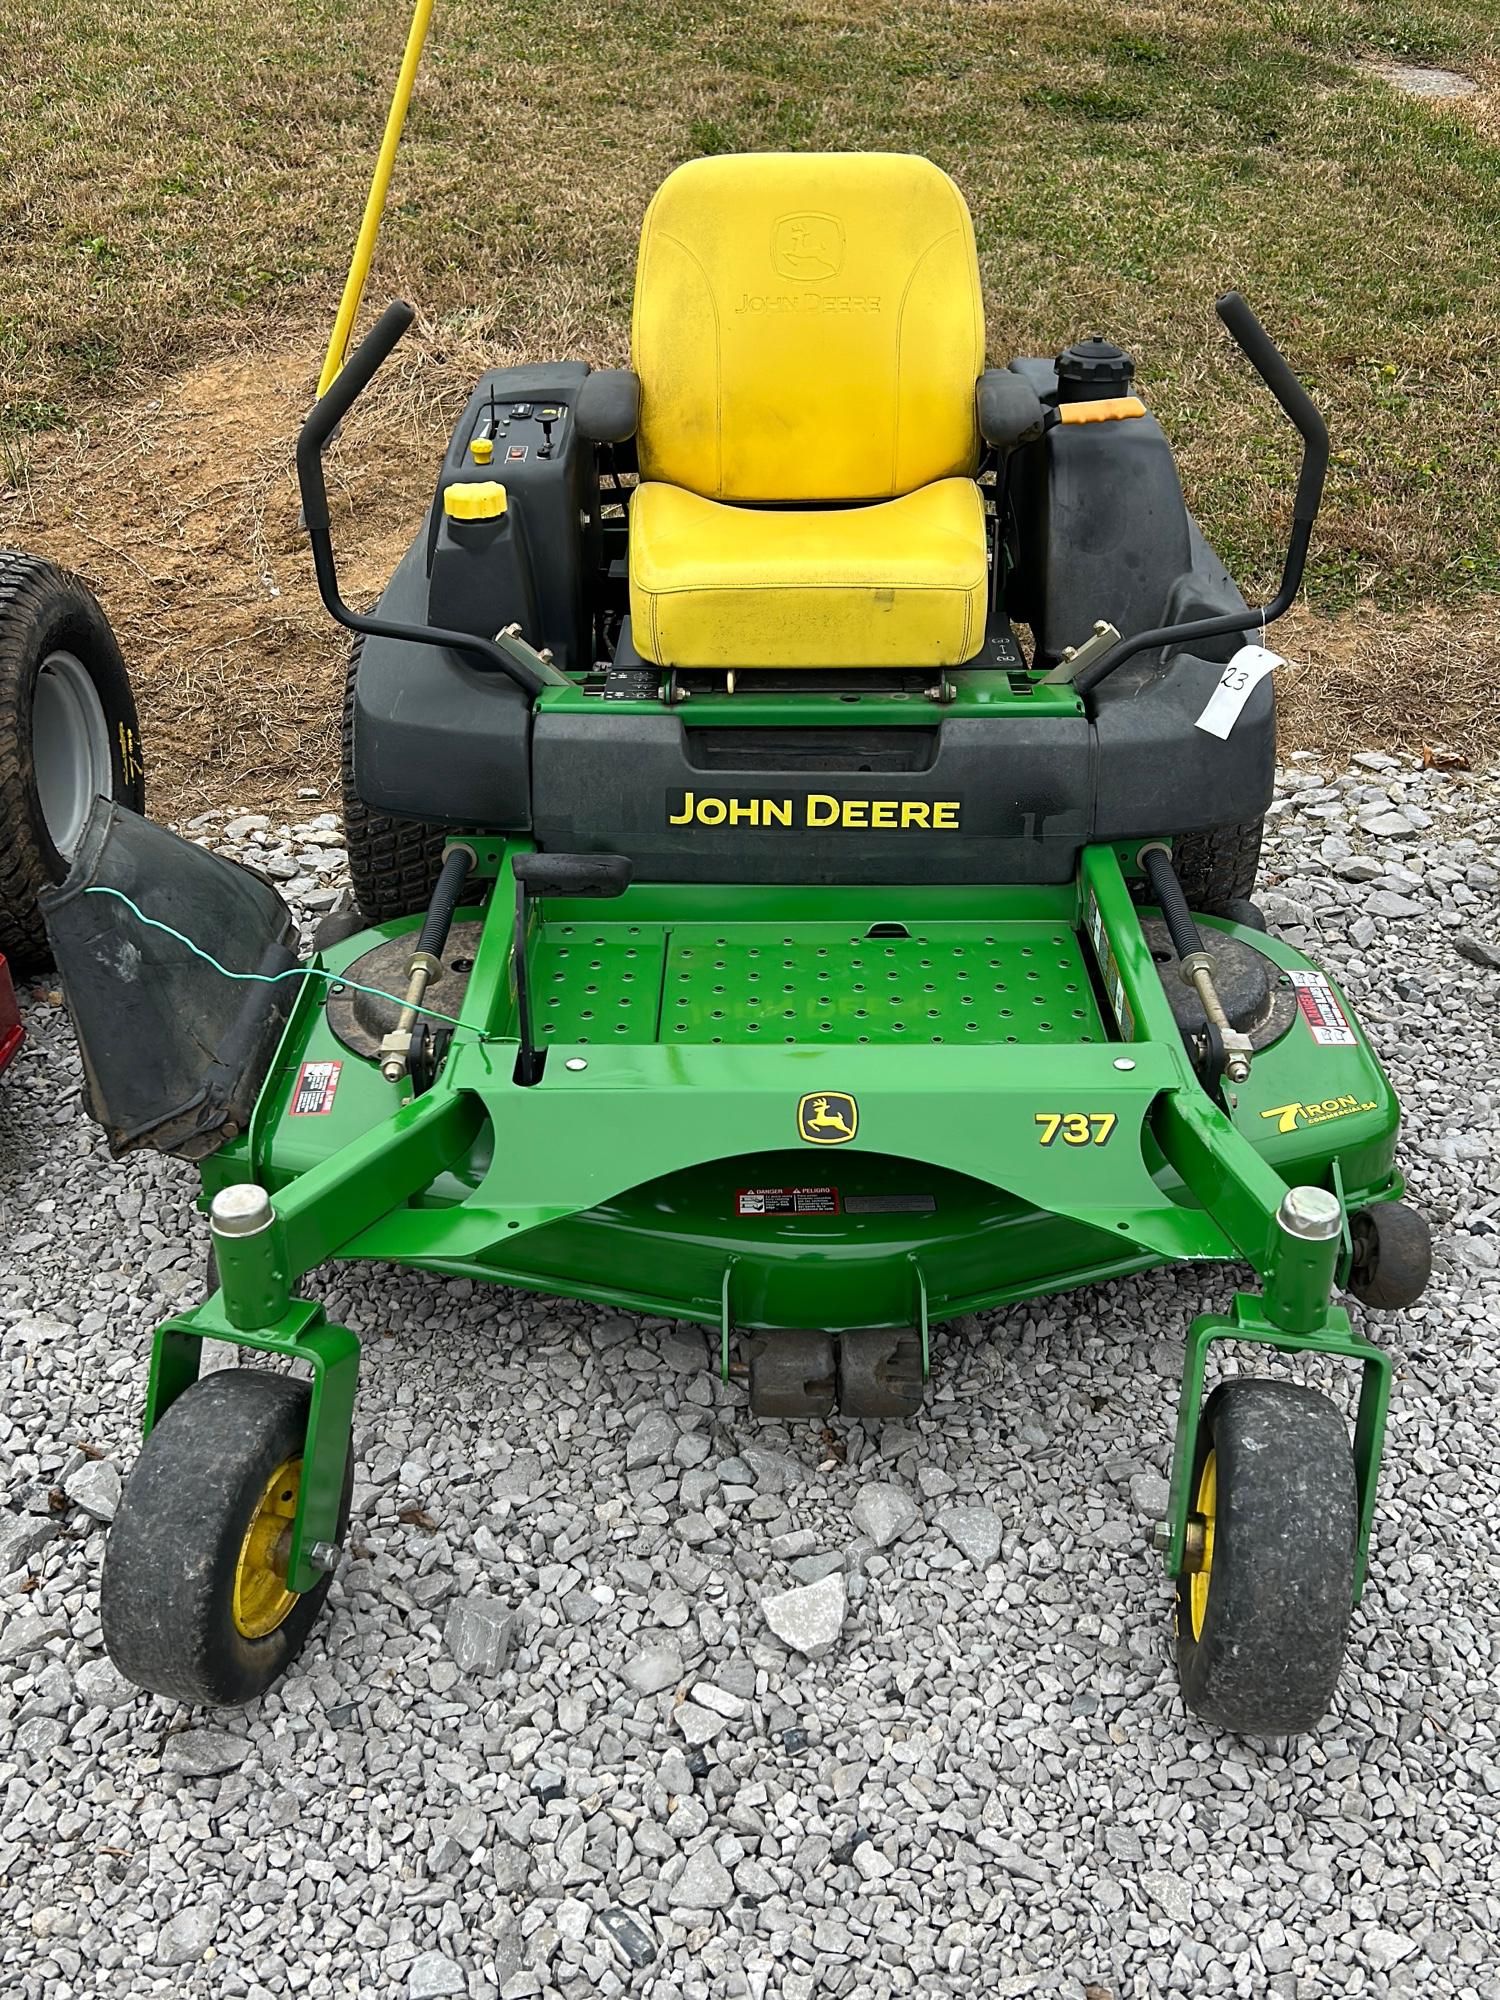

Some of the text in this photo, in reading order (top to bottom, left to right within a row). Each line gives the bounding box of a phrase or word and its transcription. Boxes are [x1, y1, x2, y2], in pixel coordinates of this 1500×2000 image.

[735, 293, 881, 314] JOHN DEERE
[1221, 667, 1249, 690] 23
[669, 792, 961, 829] JOHN DEERE
[1307, 1105, 1362, 1125] COMMERCIAL
[1035, 1113, 1118, 1147] 737
